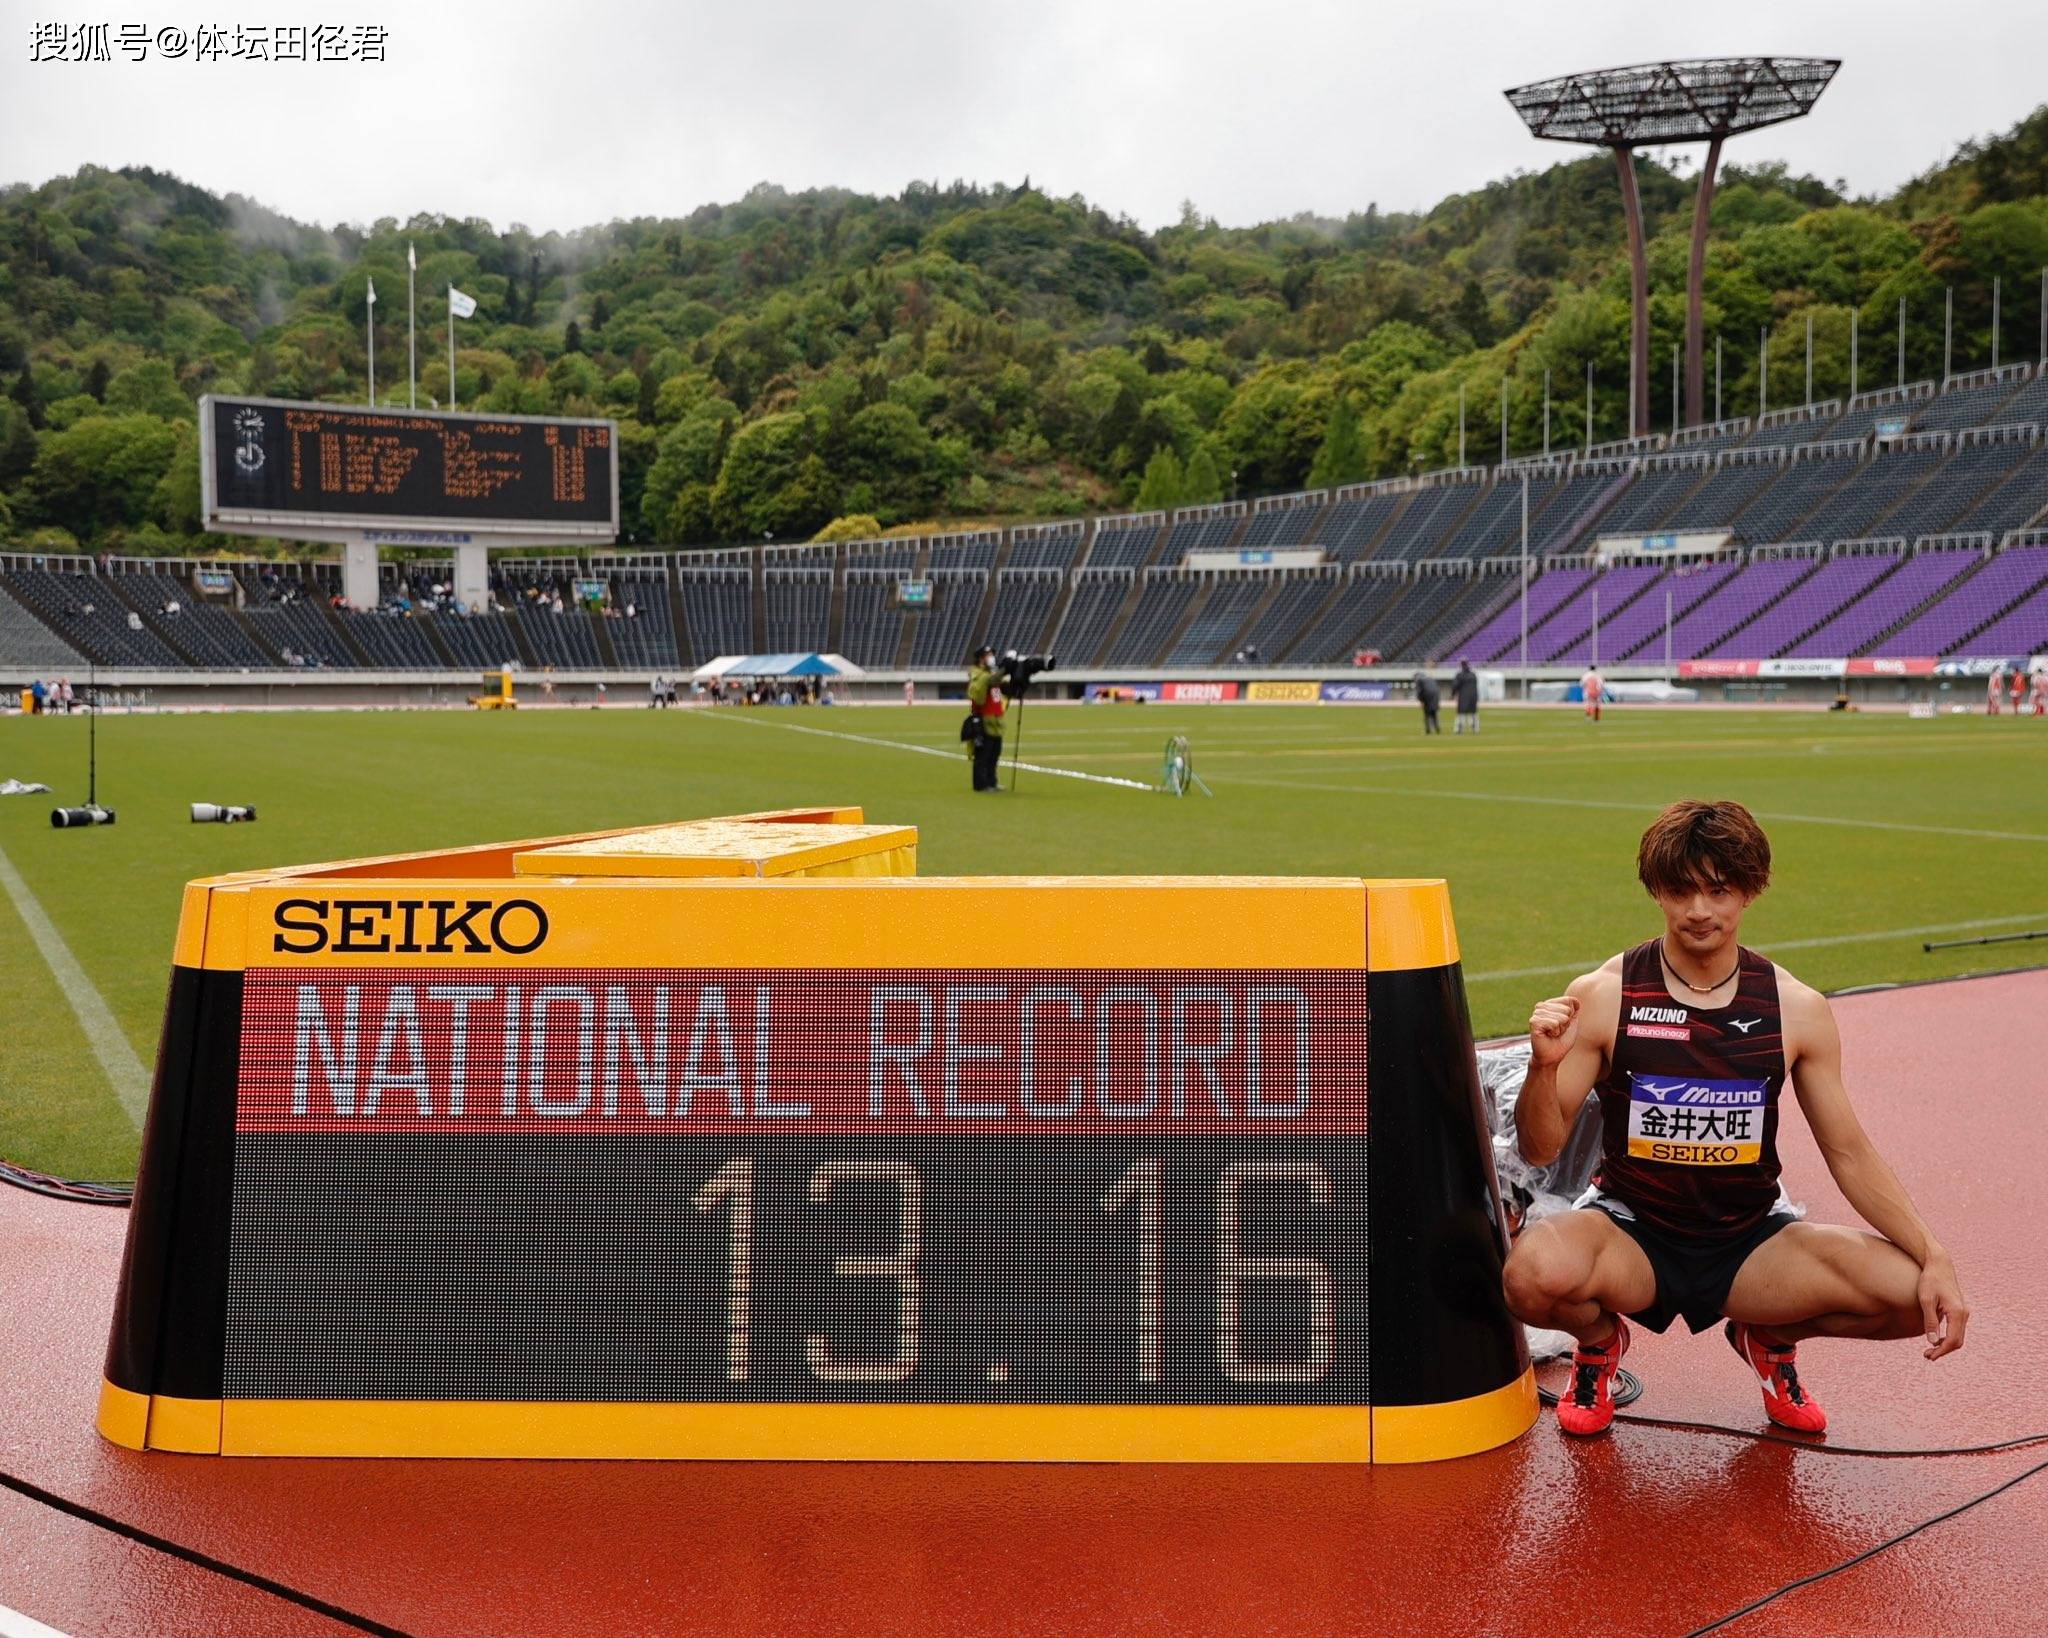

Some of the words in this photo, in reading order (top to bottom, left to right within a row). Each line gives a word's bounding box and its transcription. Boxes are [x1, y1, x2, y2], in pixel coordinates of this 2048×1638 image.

[1175, 684, 1223, 699] KIRIN
[1254, 684, 1314, 700] SEIKO
[273, 899, 549, 955] SEIKO
[1630, 1006, 1688, 1024] MIZUNO
[292, 984, 812, 1117] NATIONAL
[868, 984, 1310, 1118] RECORD
[1640, 1106, 1753, 1141] 金井大旺
[1652, 1143, 1738, 1163] SEIKO
[692, 1157, 1335, 1382] 13.16
